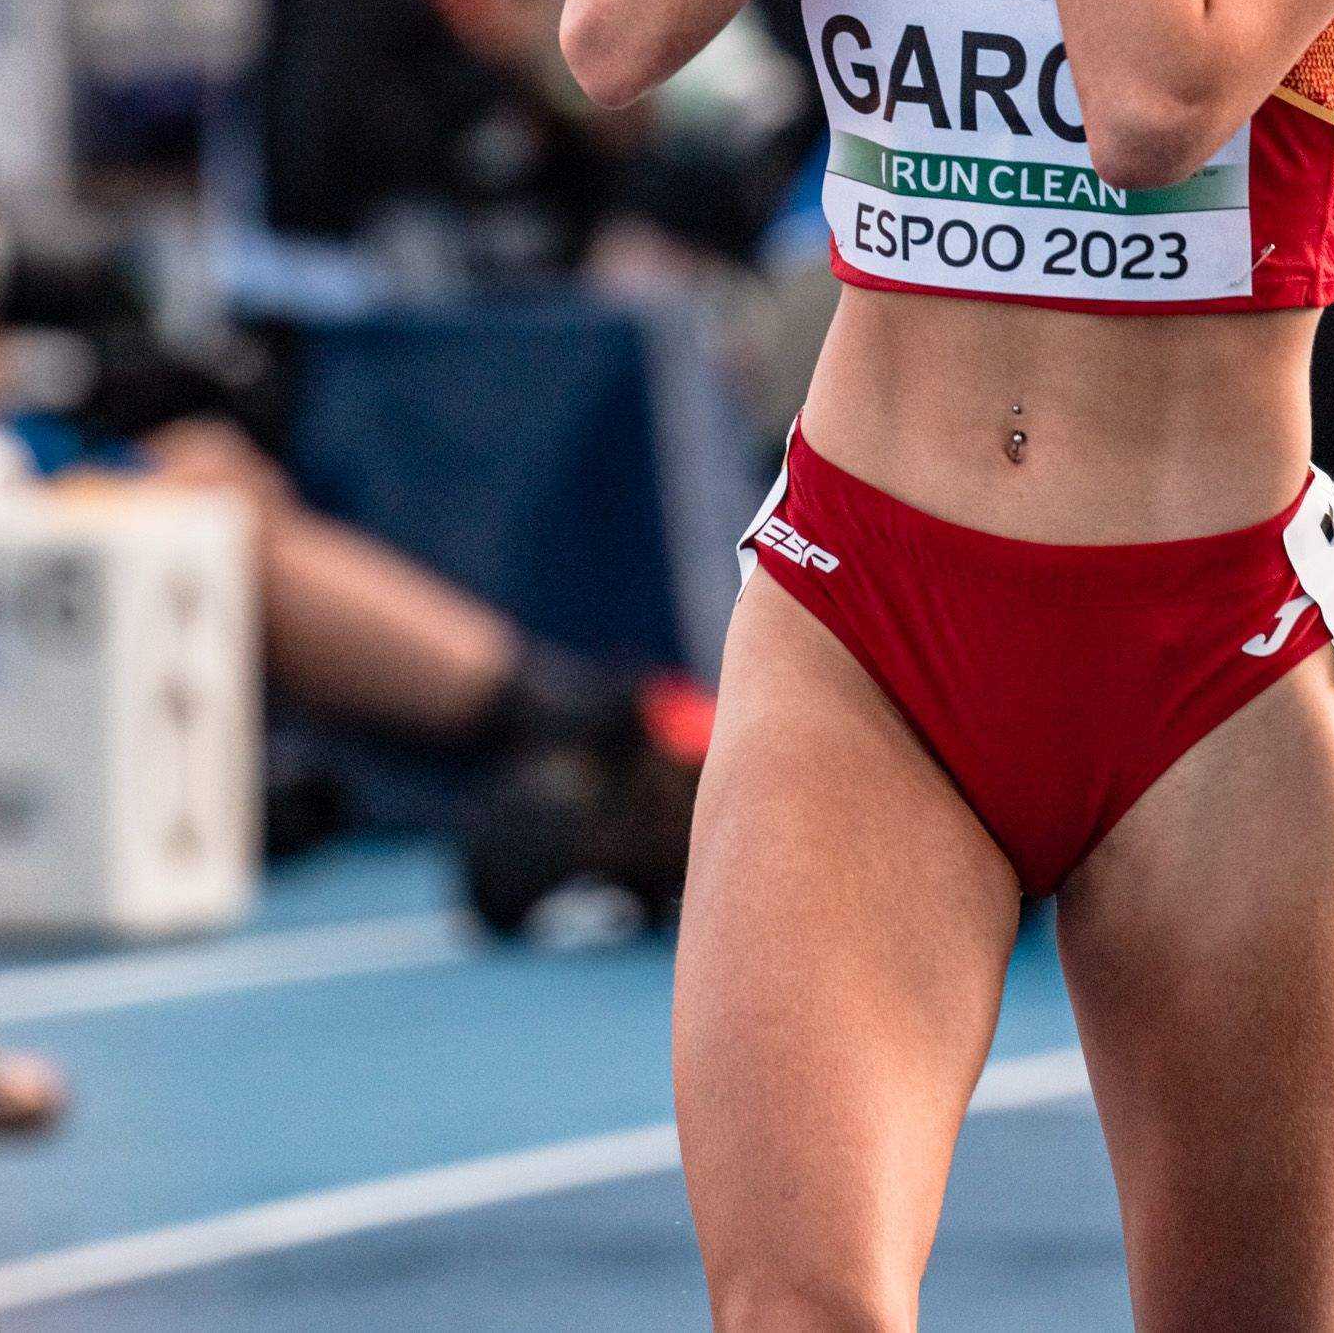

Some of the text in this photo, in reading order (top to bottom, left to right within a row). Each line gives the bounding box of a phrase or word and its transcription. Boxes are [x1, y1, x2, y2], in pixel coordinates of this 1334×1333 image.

[821, 14, 1087, 143] GARC
[892, 155, 978, 196] RUN
[988, 165, 1128, 209] CLEAN
[854, 202, 1188, 280] ESPOO 2023
[753, 515, 841, 574] ESP
